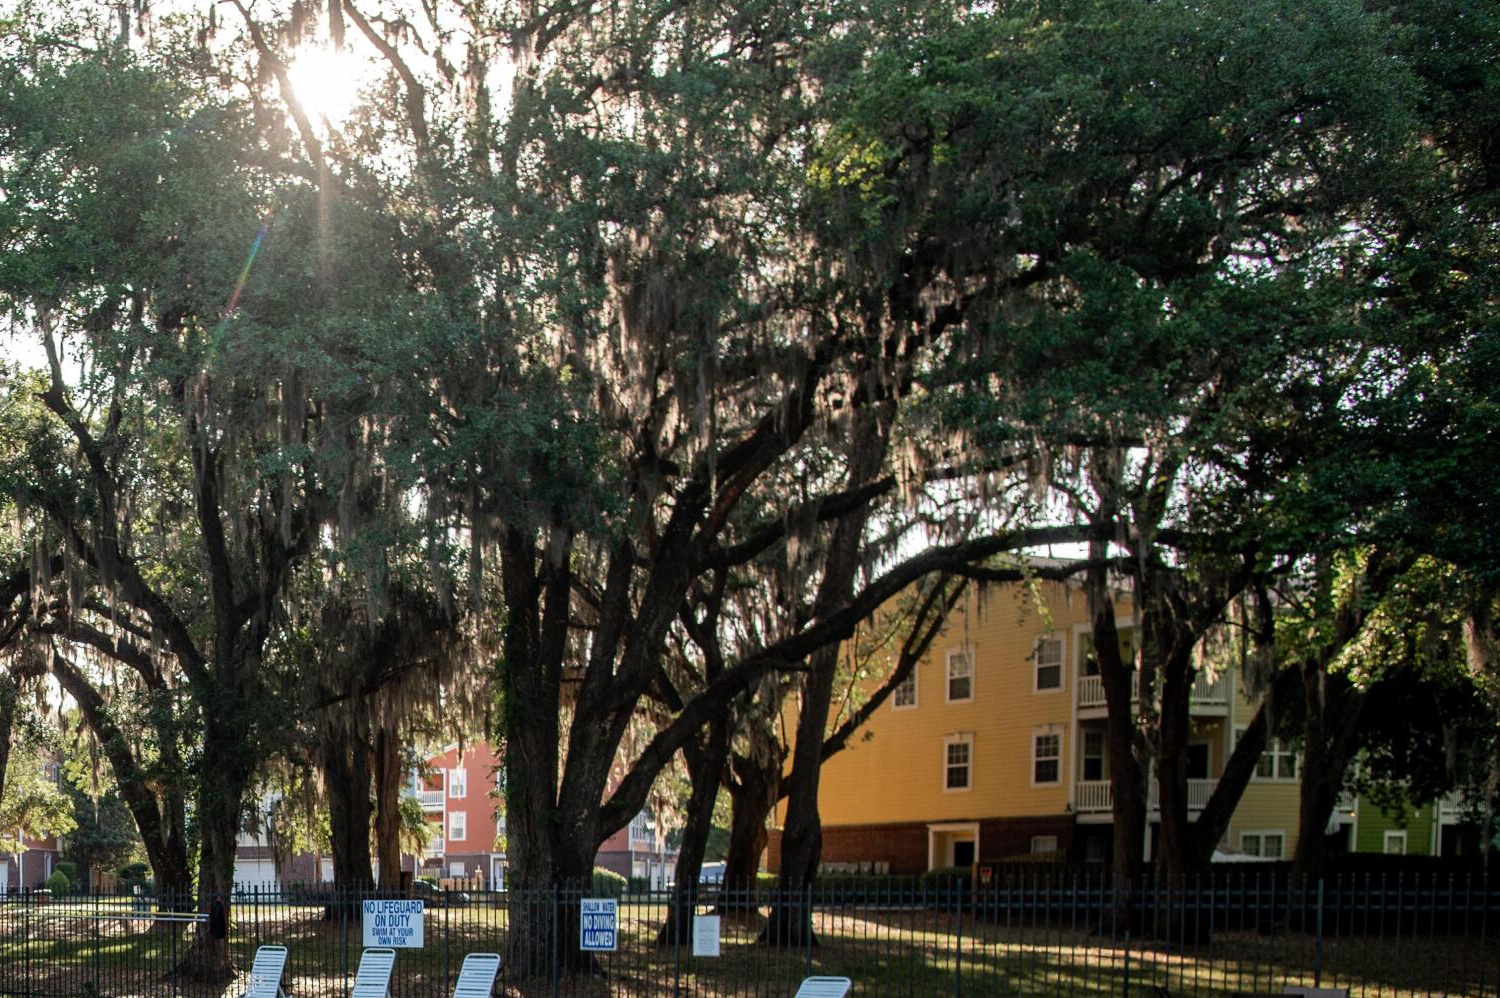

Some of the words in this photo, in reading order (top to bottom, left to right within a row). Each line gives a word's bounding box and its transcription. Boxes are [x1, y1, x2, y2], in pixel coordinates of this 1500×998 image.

[364, 901, 376, 914] NO
[377, 901, 422, 914] LIFEGUARD
[583, 902, 600, 912] SHALLOW
[602, 902, 615, 912] WATER
[375, 915, 386, 927] ON
[388, 914, 411, 927] DUTY
[583, 915, 593, 929] NO
[594, 915, 614, 930] DIVING
[372, 928, 388, 936] SWIM
[389, 928, 396, 936] AT
[397, 928, 414, 937] YOUR
[584, 931, 613, 947] ALLOWED
[378, 937, 392, 945] OWN
[393, 937, 407, 945] RISK
